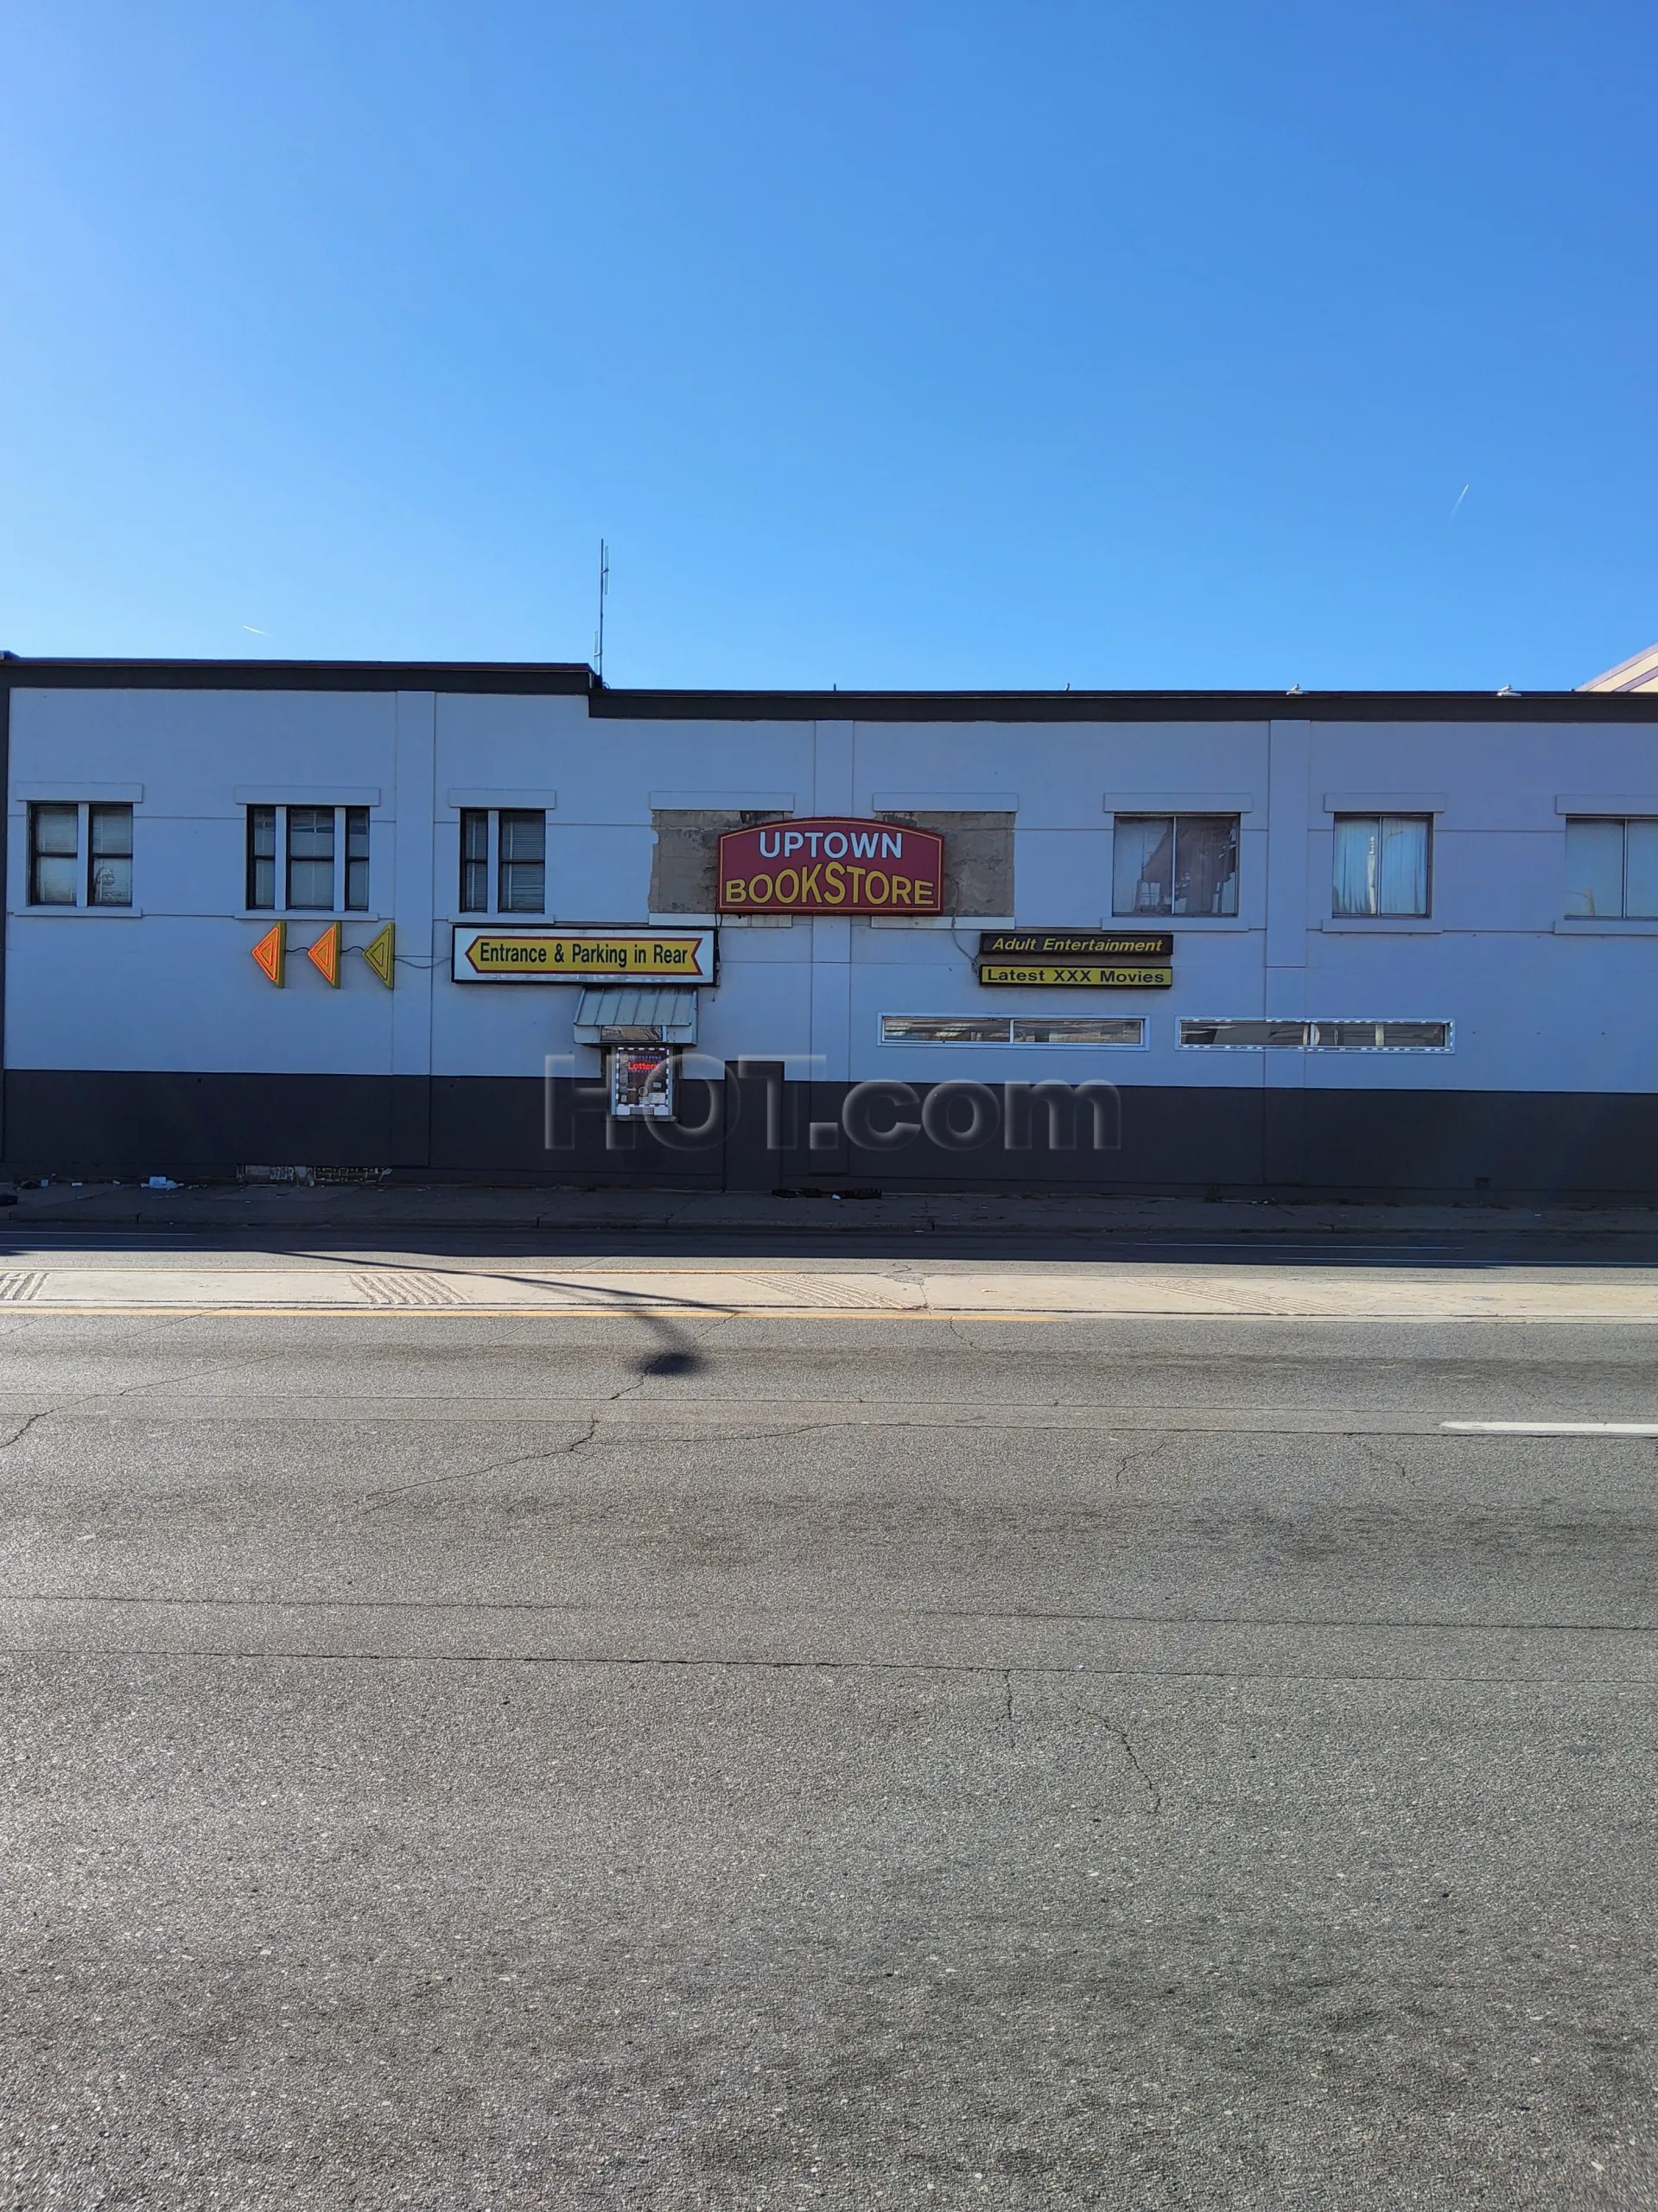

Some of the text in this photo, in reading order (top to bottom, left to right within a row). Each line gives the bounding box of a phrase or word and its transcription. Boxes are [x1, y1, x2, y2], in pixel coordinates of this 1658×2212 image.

[759, 831, 903, 859] UPTOWN
[725, 861, 934, 905] BOOKSTORE
[480, 942, 688, 968] Entrance & Parking in Rear
[993, 938, 1163, 952] Adult Entertainment
[988, 969, 1165, 983] Latest XXX Movies
[628, 1062, 661, 1071] Lottery
